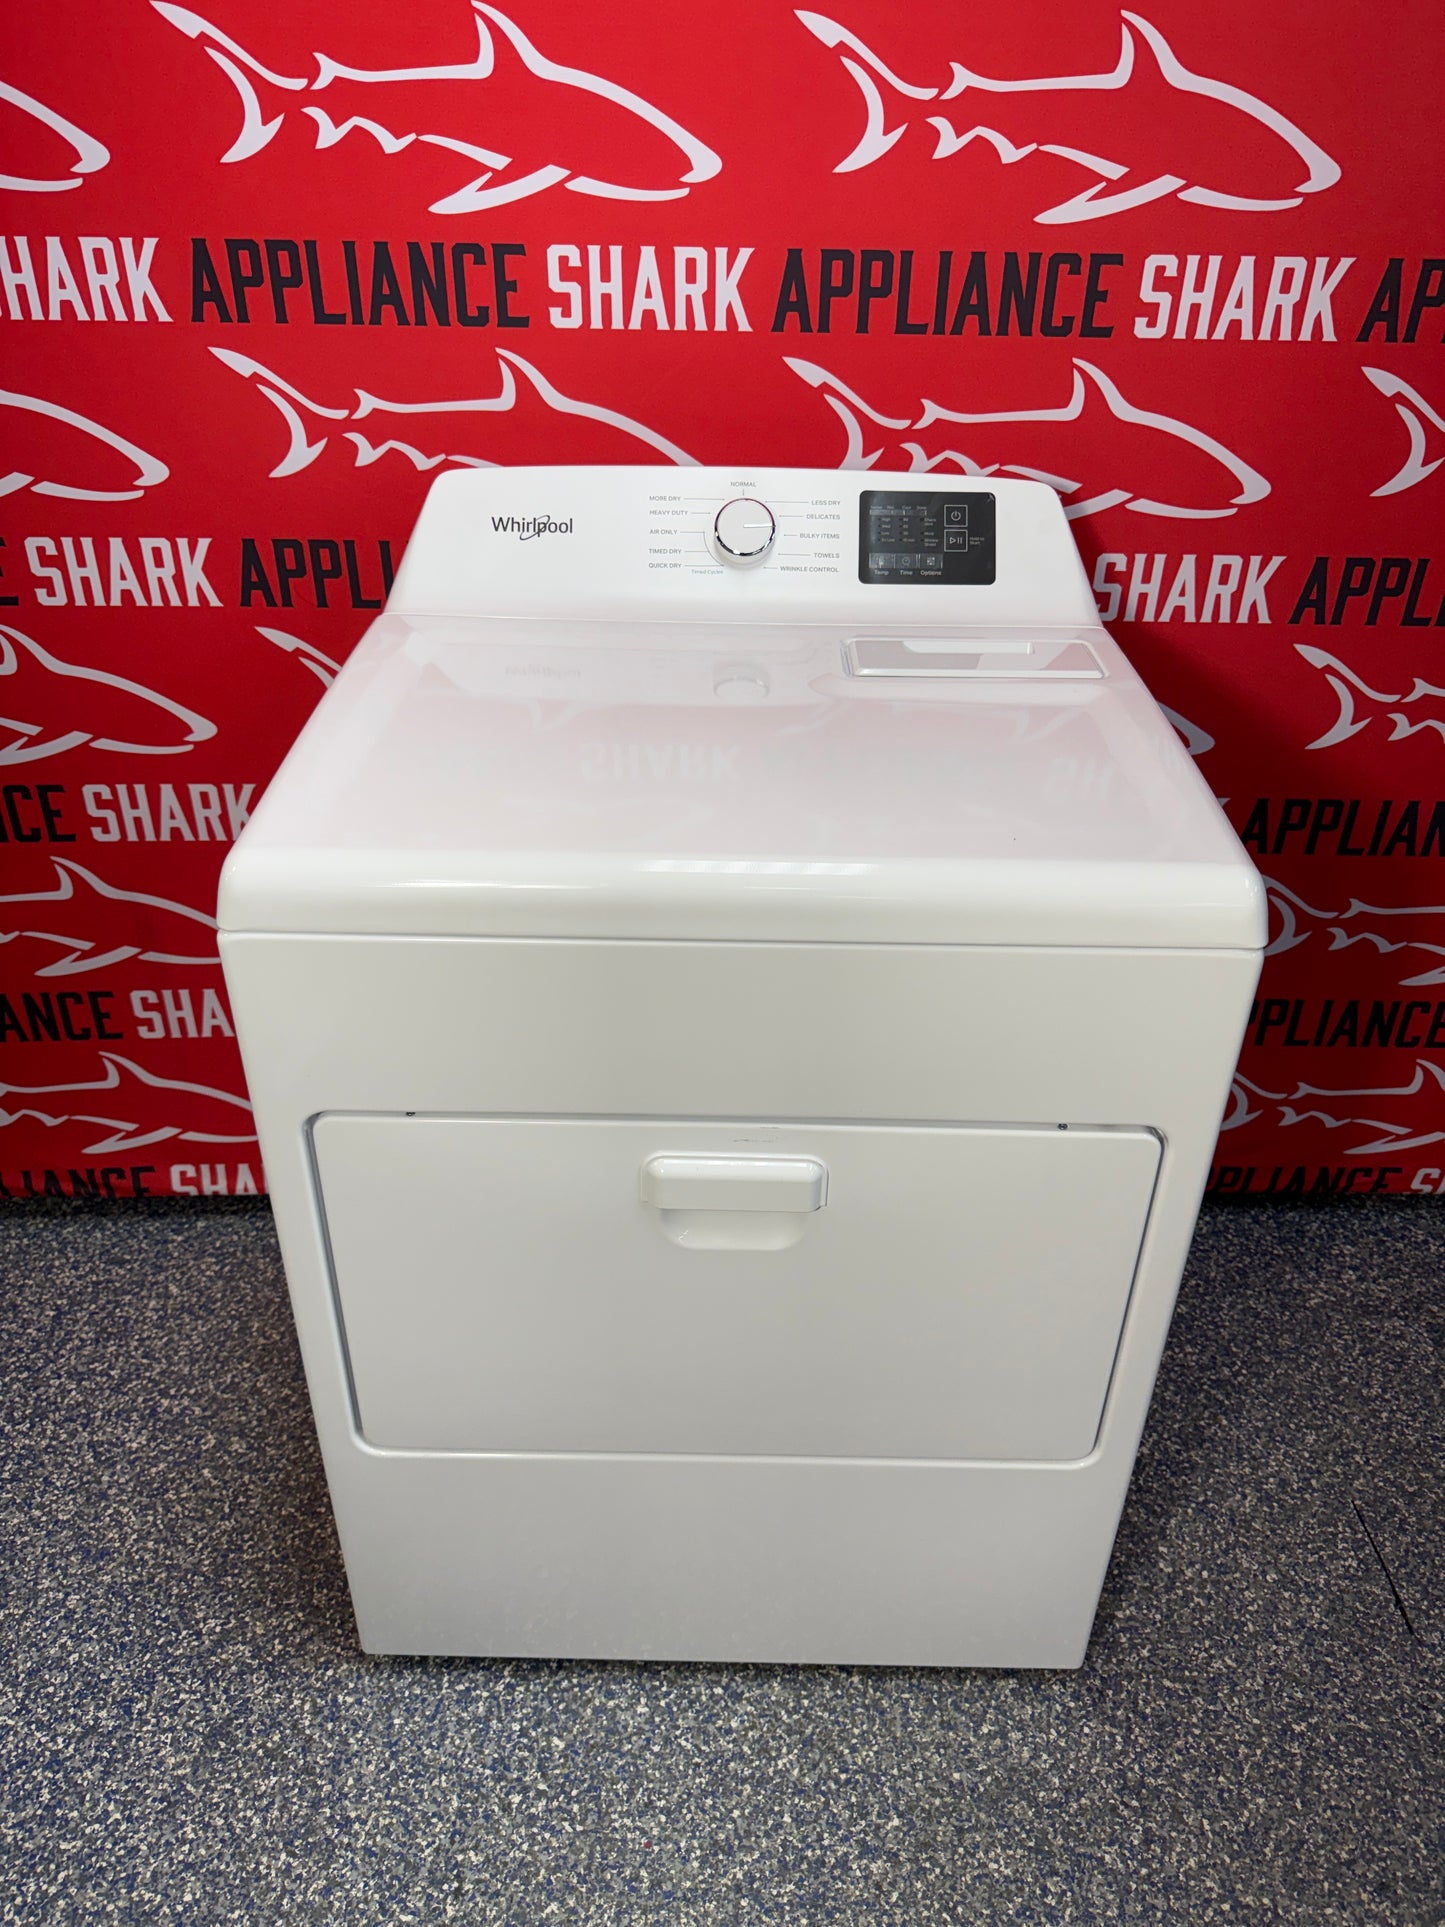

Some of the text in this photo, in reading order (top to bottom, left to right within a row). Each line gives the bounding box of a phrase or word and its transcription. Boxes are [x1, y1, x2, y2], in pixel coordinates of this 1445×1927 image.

[0, 236, 1445, 345] HARK APPLIANCE SHARK APPLIANCE SHARK AP
[491, 516, 573, 539] Whirlpool
[24, 536, 225, 608] SHARK
[239, 538, 411, 609] APPLI
[1092, 552, 1288, 625] SHARK
[0, 784, 76, 843] CE
[170, 1163, 269, 1196] SHA
